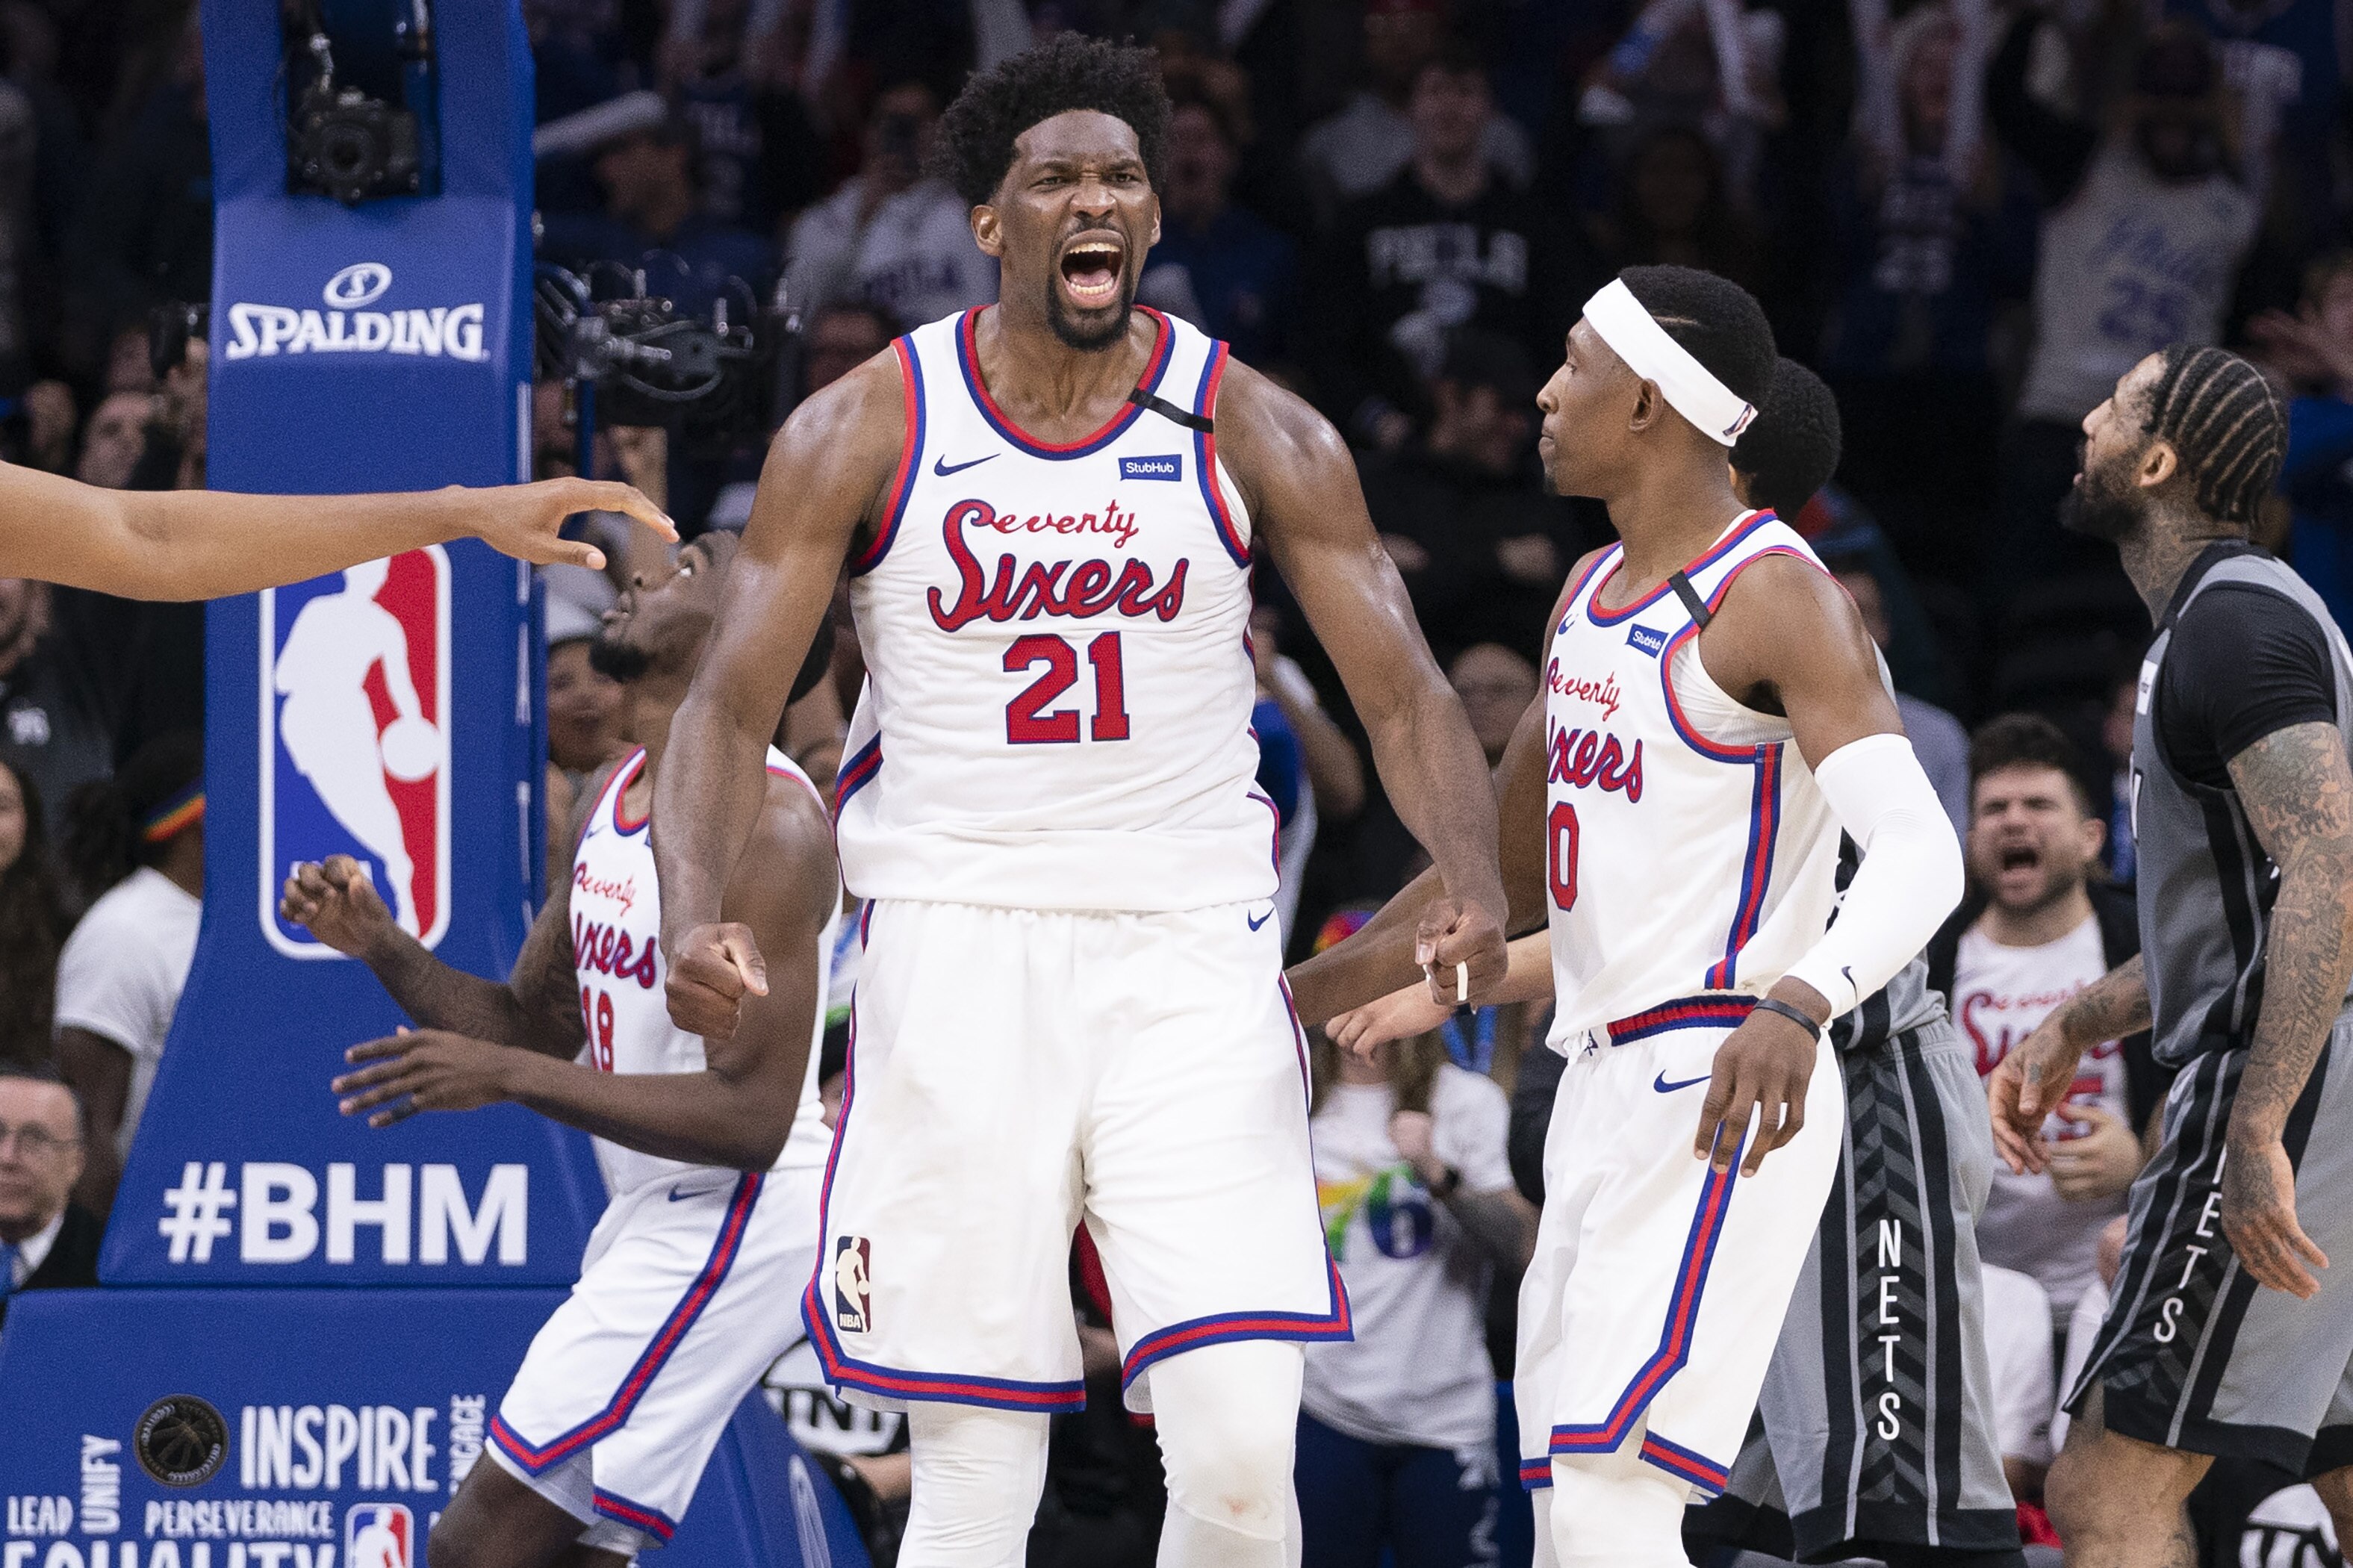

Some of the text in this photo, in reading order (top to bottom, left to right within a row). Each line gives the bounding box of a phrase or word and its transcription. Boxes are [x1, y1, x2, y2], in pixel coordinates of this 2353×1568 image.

[226, 302, 485, 362] SPALDING
[1125, 461, 1175, 473] StubHub
[942, 498, 1140, 549] Seventy
[927, 553, 1190, 633] Sixers
[1632, 630, 1662, 651] StubHub
[1003, 630, 1131, 744] 21
[159, 1162, 528, 1265] #BHM
[839, 1313, 861, 1329] NBA
[1877, 1219, 1902, 1441] NETS
[241, 1404, 439, 1491] INSPIRE
[81, 1435, 120, 1534] UNIFY
[7, 1496, 73, 1536] LEAD
[145, 1500, 336, 1538] PERSEVERANCE
